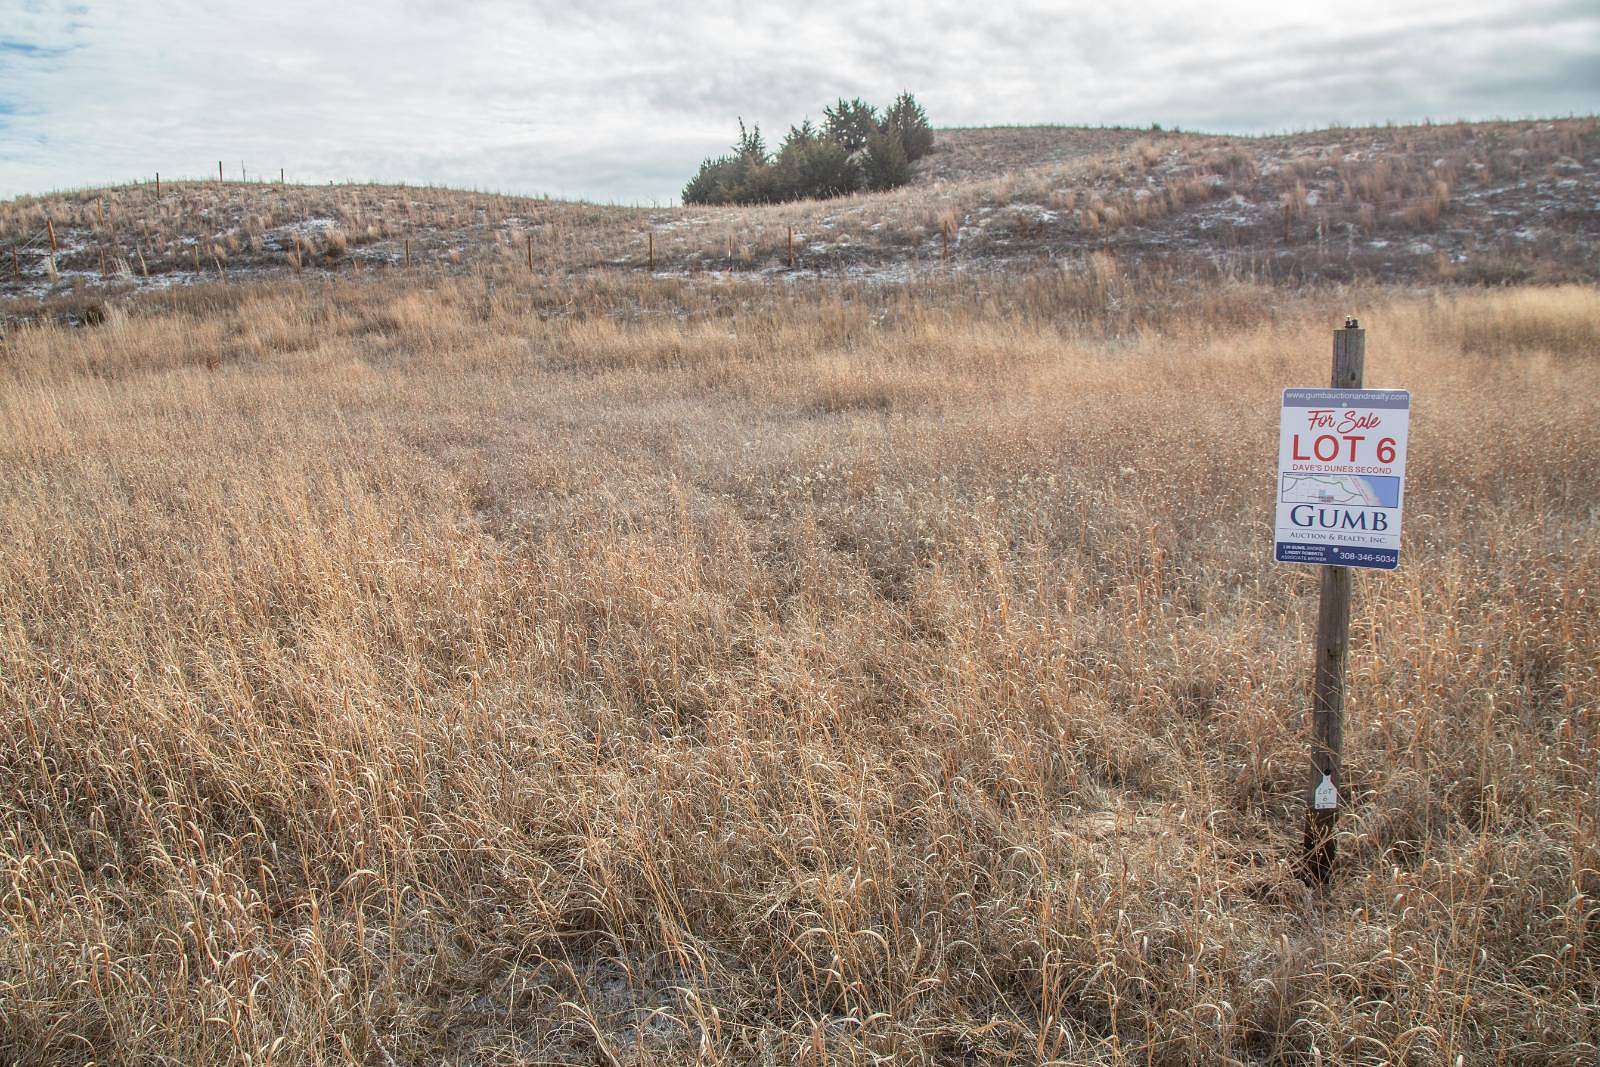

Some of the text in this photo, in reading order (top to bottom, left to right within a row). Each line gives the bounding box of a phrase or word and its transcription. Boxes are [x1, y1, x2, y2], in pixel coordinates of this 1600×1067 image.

[1286, 391, 1408, 402] www.gumbauctionandrealty.com
[1307, 410, 1381, 434] For Sale
[1292, 434, 1397, 464] LOT 6
[1292, 463, 1392, 475] DAVE'S DUNES SECOND
[1290, 504, 1388, 531] GUMB
[1339, 552, 1396, 563] 308-346-5034
